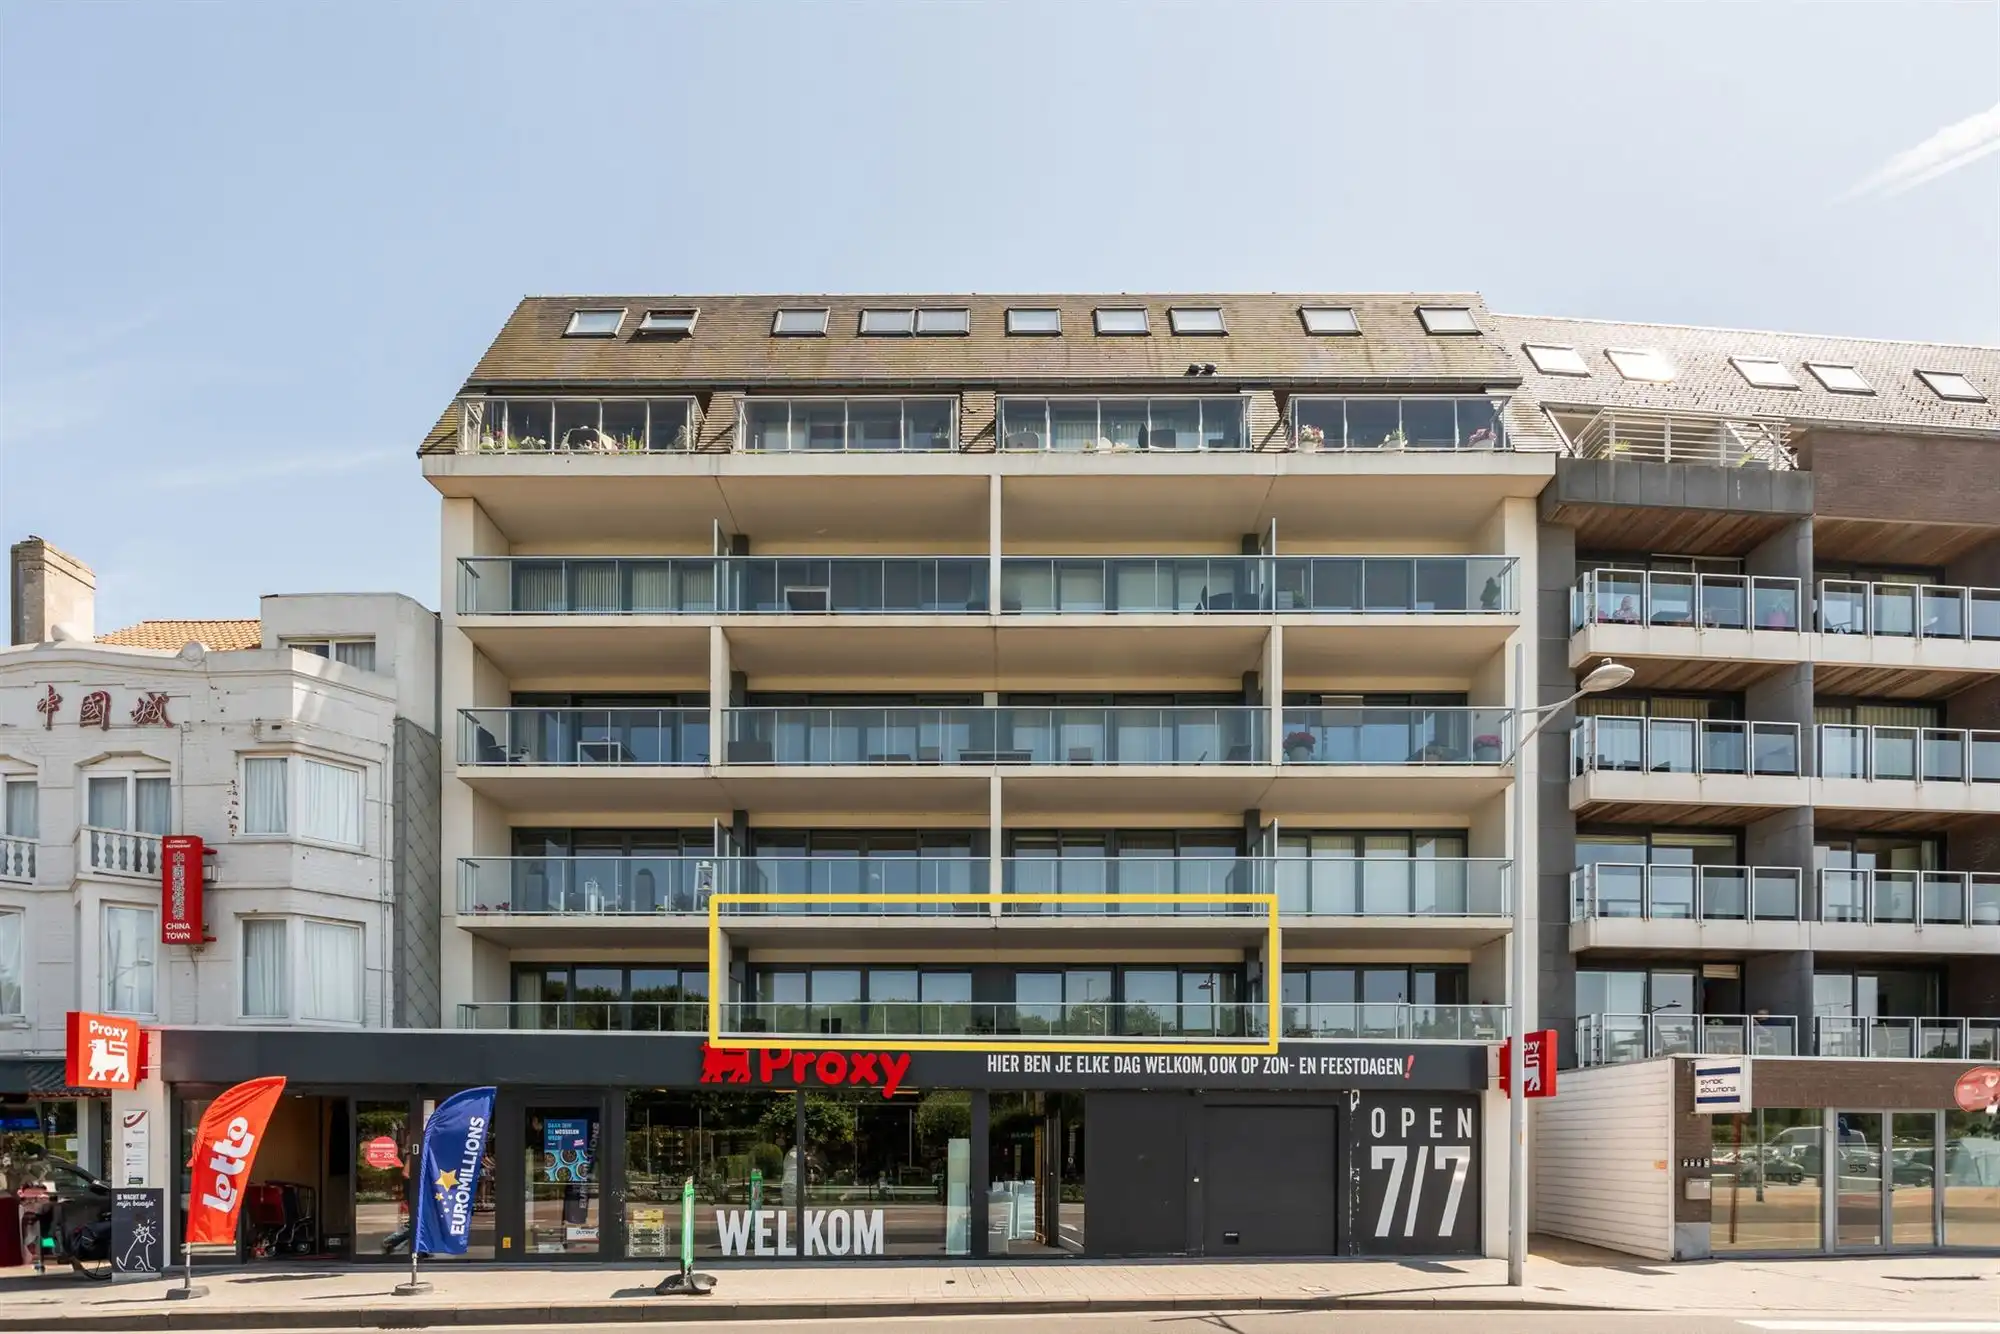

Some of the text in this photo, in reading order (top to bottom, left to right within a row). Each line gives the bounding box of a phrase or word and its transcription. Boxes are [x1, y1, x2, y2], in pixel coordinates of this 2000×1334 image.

[166, 932, 191, 940] TOWN
[89, 1020, 128, 1042] Proxy
[760, 1048, 911, 1099] Proxy
[987, 1055, 1414, 1078] HIER BEN JE ELKE DAG WELKOM, OOK OP ZON- EN FEESTDAGEN!
[1371, 1107, 1472, 1138] OPEN
[202, 1116, 255, 1213] Lotto
[450, 1116, 485, 1235] EUROMILLIONS
[1849, 1163, 1868, 1173] 55
[1371, 1146, 1471, 1236] 7/7
[716, 1209, 884, 1256] WELKOM
